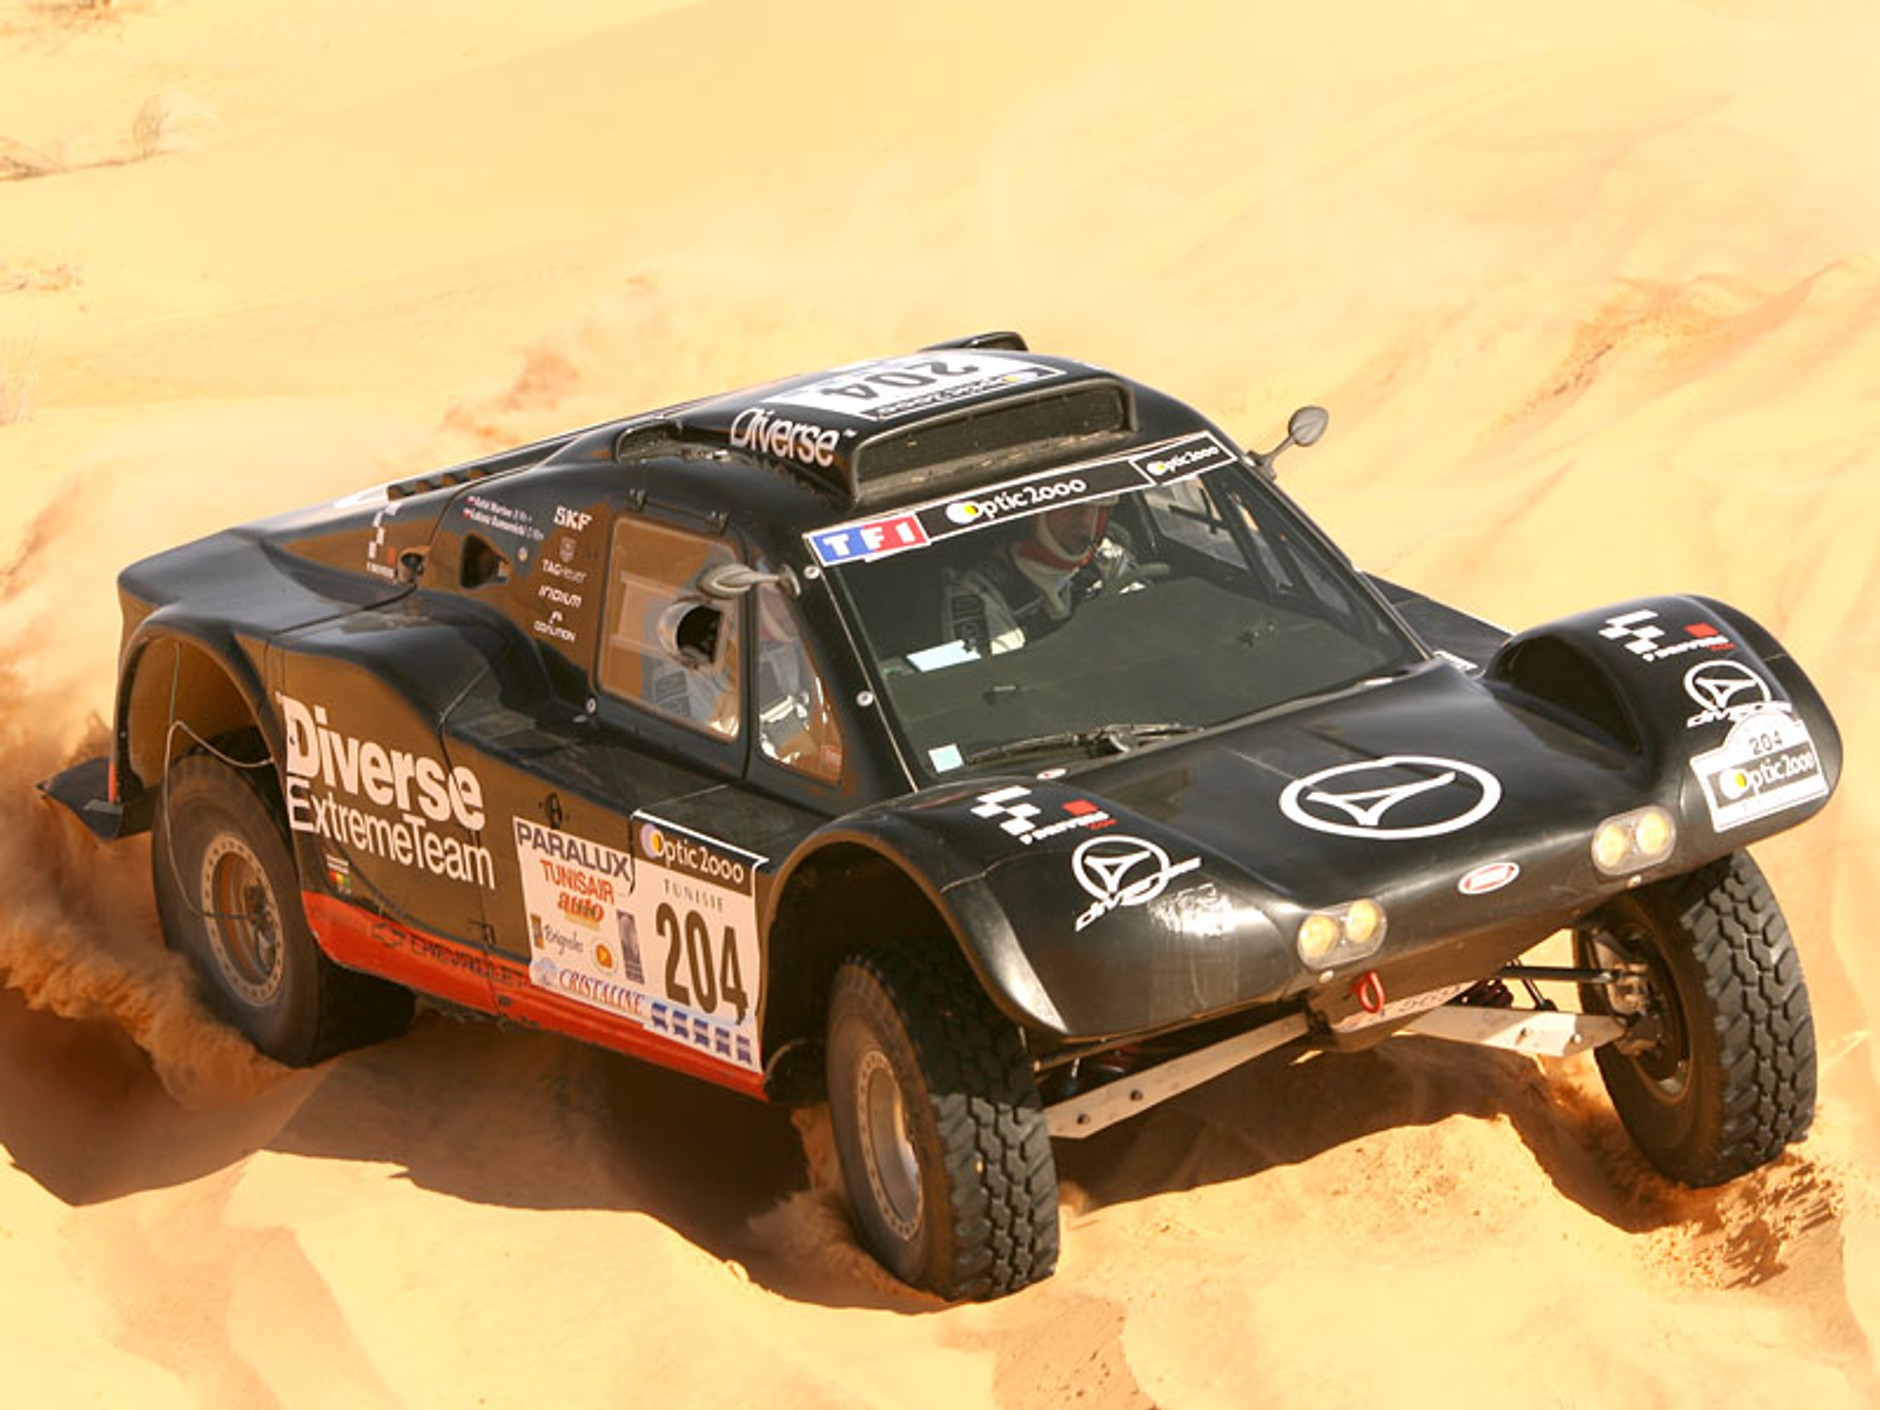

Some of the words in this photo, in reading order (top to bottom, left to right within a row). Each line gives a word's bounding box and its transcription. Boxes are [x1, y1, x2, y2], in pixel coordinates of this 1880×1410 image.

[820, 361, 980, 400] 204
[730, 407, 840, 467] Diverse
[554, 505, 593, 531] SKF
[945, 478, 1087, 525] Optic2000
[277, 692, 486, 832] Diverse
[1749, 730, 1783, 755] 204
[516, 822, 631, 882] PARALUX
[640, 823, 745, 884] Optic2000
[540, 859, 615, 904] TUNISAIR
[557, 892, 604, 922] auto
[656, 902, 748, 1026] 204
[558, 968, 646, 1015] CRISTALINE
